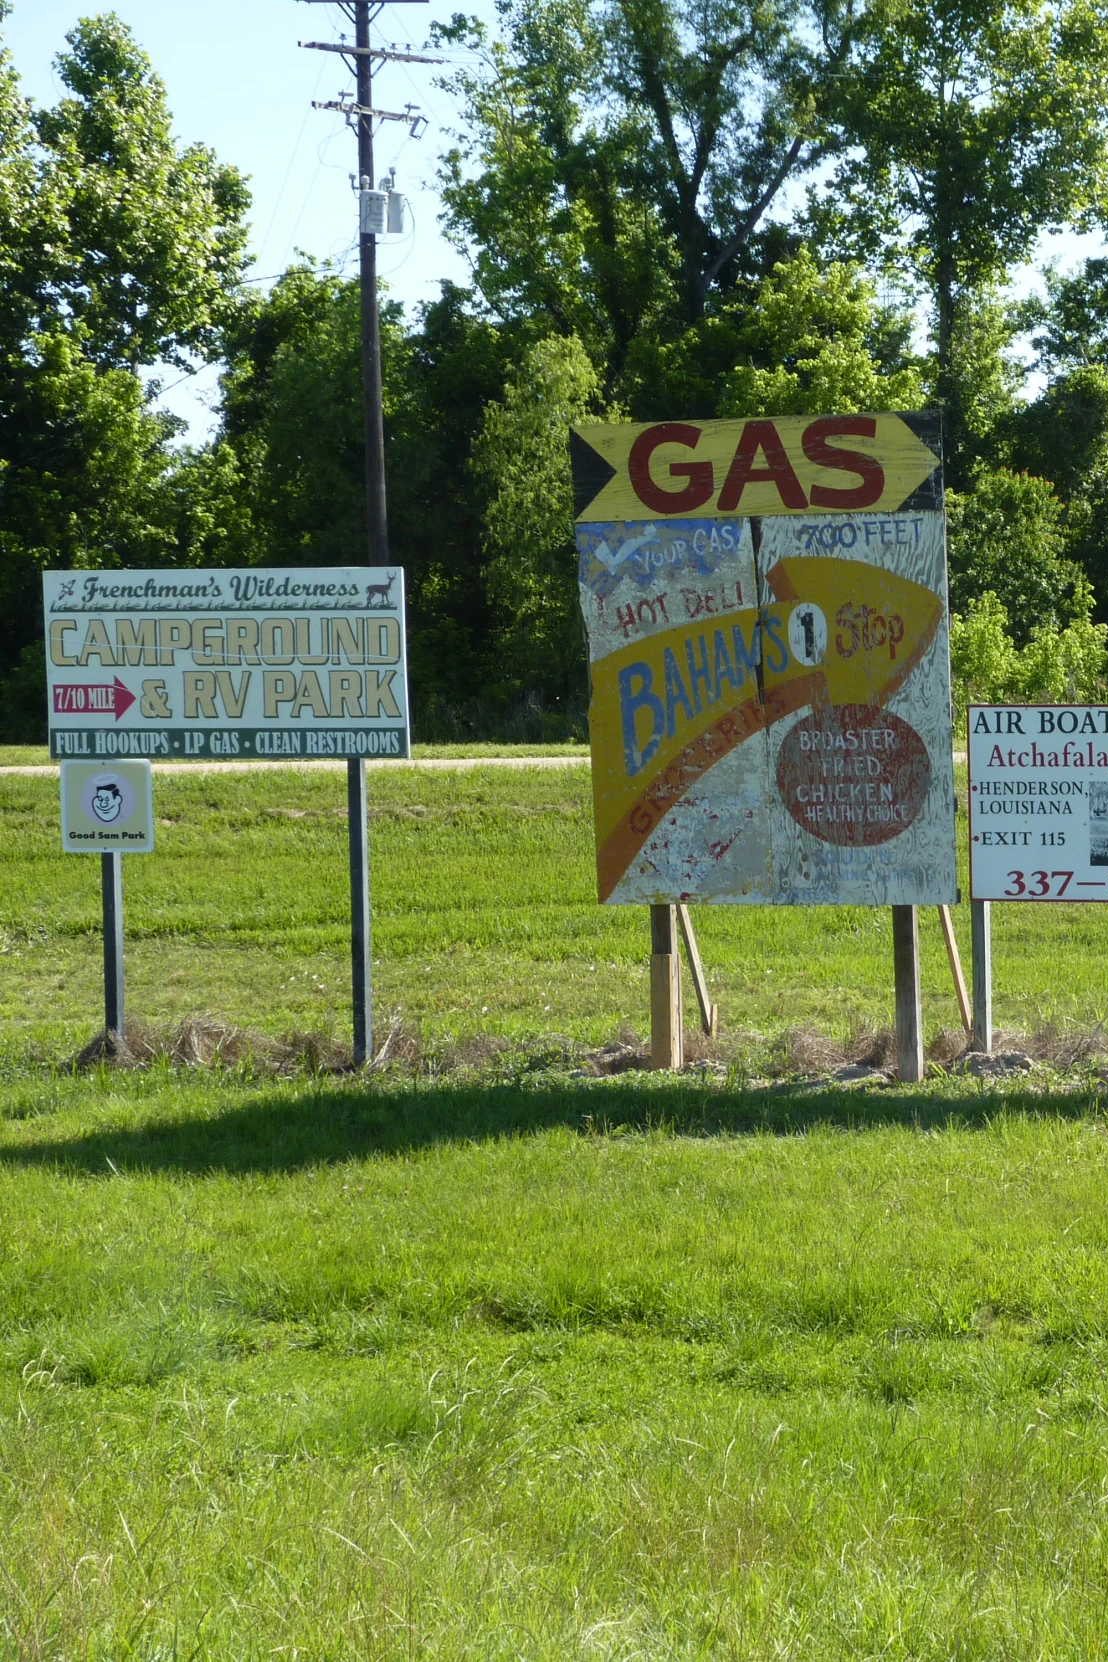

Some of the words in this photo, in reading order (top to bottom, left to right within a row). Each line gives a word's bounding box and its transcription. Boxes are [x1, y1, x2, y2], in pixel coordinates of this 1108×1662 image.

[628, 417, 886, 514] GAS
[693, 525, 735, 555] GAS
[801, 522, 857, 550] 700
[863, 518, 924, 546] FEET
[82, 576, 222, 602] Frenchman's
[230, 576, 360, 601] Wilderness
[613, 592, 670, 638] HOT
[49, 617, 402, 667] CAMPGROUND
[801, 612, 814, 658] 1
[55, 688, 86, 710] 7/10
[88, 687, 115, 709] MILE
[140, 679, 173, 718] &
[183, 670, 251, 718] RV
[263, 669, 402, 718] PARK
[973, 711, 1026, 734] AIR
[55, 732, 90, 754] FULL
[95, 732, 169, 754] HOOKUPS
[184, 732, 205, 754] LP
[209, 732, 239, 754] GAS
[255, 732, 301, 754] CLEAN
[306, 731, 400, 754] RESTROOMS
[796, 783, 894, 803] CHICKEN
[979, 781, 1089, 798] HENDERSON,
[805, 804, 864, 822] HEALTHY
[867, 804, 908, 821] CHOICE
[979, 801, 1073, 815] LOUISIANA
[69, 830, 96, 840] Good
[98, 830, 119, 840] Sam
[121, 830, 146, 840] Park
[982, 832, 1032, 846] EXIT
[1041, 832, 1065, 846] 115
